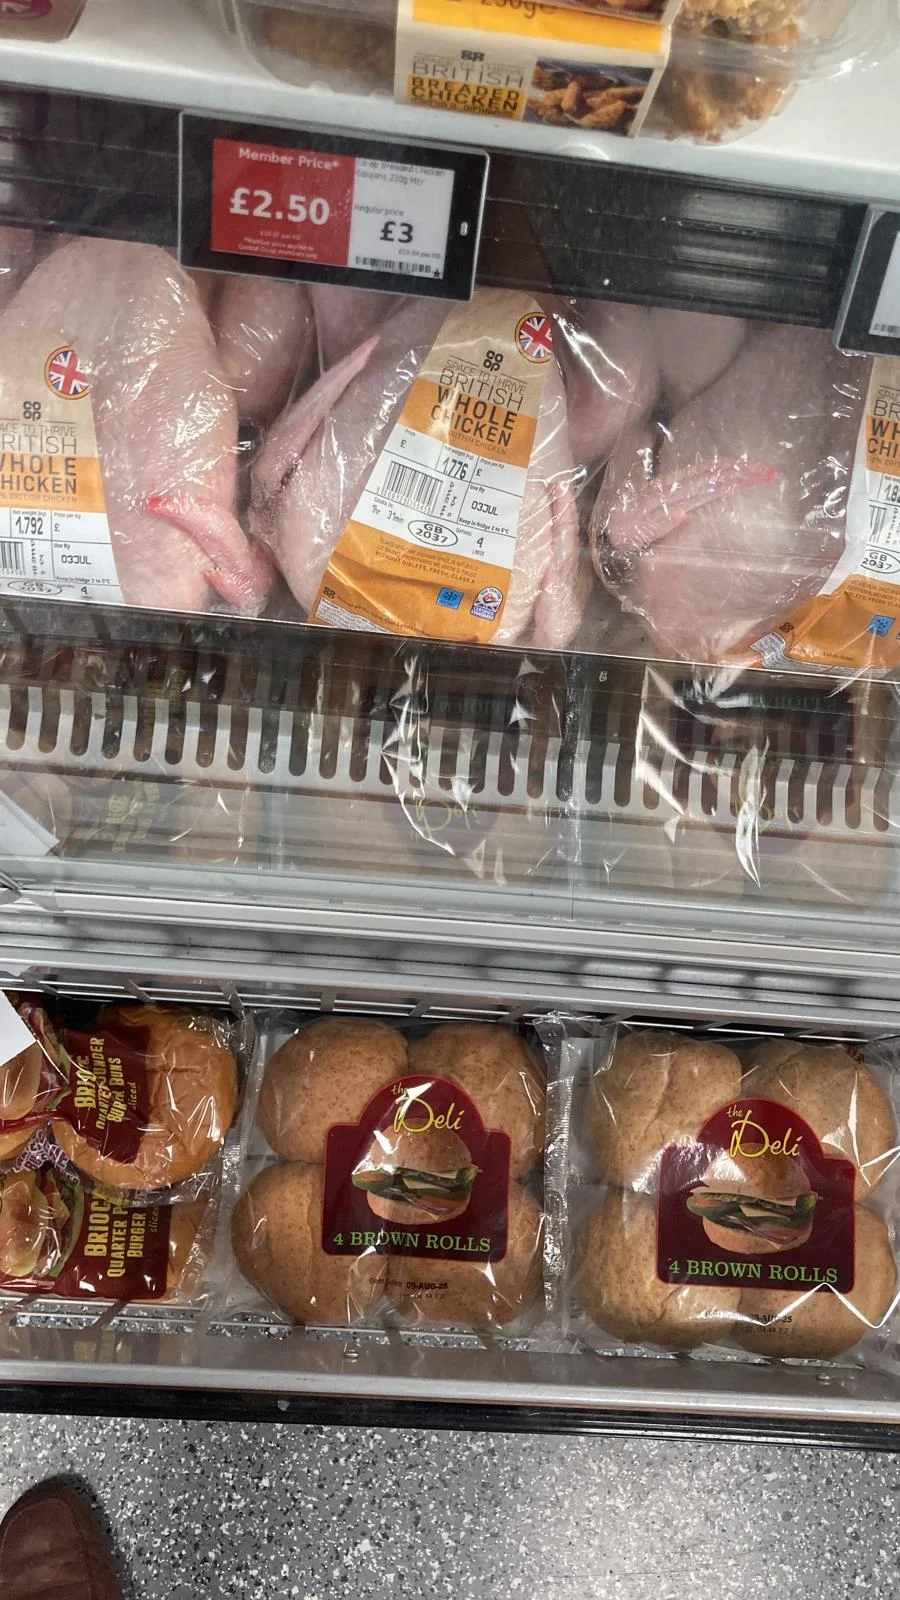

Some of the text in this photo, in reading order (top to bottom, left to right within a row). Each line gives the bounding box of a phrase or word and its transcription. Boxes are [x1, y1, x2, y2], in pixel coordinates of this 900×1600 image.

[413, 61, 523, 88] BRITISH
[411, 87, 518, 112] CHICKEN
[412, 77, 519, 101] BREADED
[238, 147, 294, 165] Member
[229, 187, 330, 226] £2.50
[354, 204, 404, 217] Regular price
[379, 220, 414, 244] £3
[445, 359, 528, 395] SPACE TO THRIVE
[440, 367, 524, 412] BRITISH
[437, 386, 518, 430] WHOLE
[873, 399, 900, 421] BR
[0, 423, 77, 438] ACE TO THRIVE
[431, 404, 511, 447] CHICKEN
[871, 417, 900, 440] WH
[1, 433, 77, 455] RITISH
[399, 439, 406, 449] £
[475, 438, 507, 456] CHICKEN
[868, 437, 898, 459] CHI
[443, 456, 469, 480] 1.776
[476, 468, 483, 477] £
[1, 473, 77, 495] HICKEN
[471, 500, 499, 516] 03JUL
[15, 516, 43, 535] 1.792
[54, 523, 60, 532] £
[423, 523, 443, 534] GB
[459, 517, 470, 526] Keep
[476, 521, 491, 531] fridge
[415, 528, 449, 543] 2037
[476, 536, 484, 549] 4
[61, 554, 92, 565] 03JUL
[862, 557, 893, 571] 2037
[869, 551, 888, 562] GB
[81, 586, 88, 594] 4
[108, 1057, 125, 1087] BUNS
[393, 1091, 466, 1133] Deli
[726, 1103, 744, 1118] the
[729, 1109, 803, 1158] Deli
[84, 1199, 111, 1257] BRIOC
[127, 1212, 147, 1258] BURGER
[107, 1220, 128, 1278] QUARTER
[332, 1231, 492, 1253] 4 BROWN ROLLS
[669, 1260, 838, 1284] 4 BROWN ROLLS
